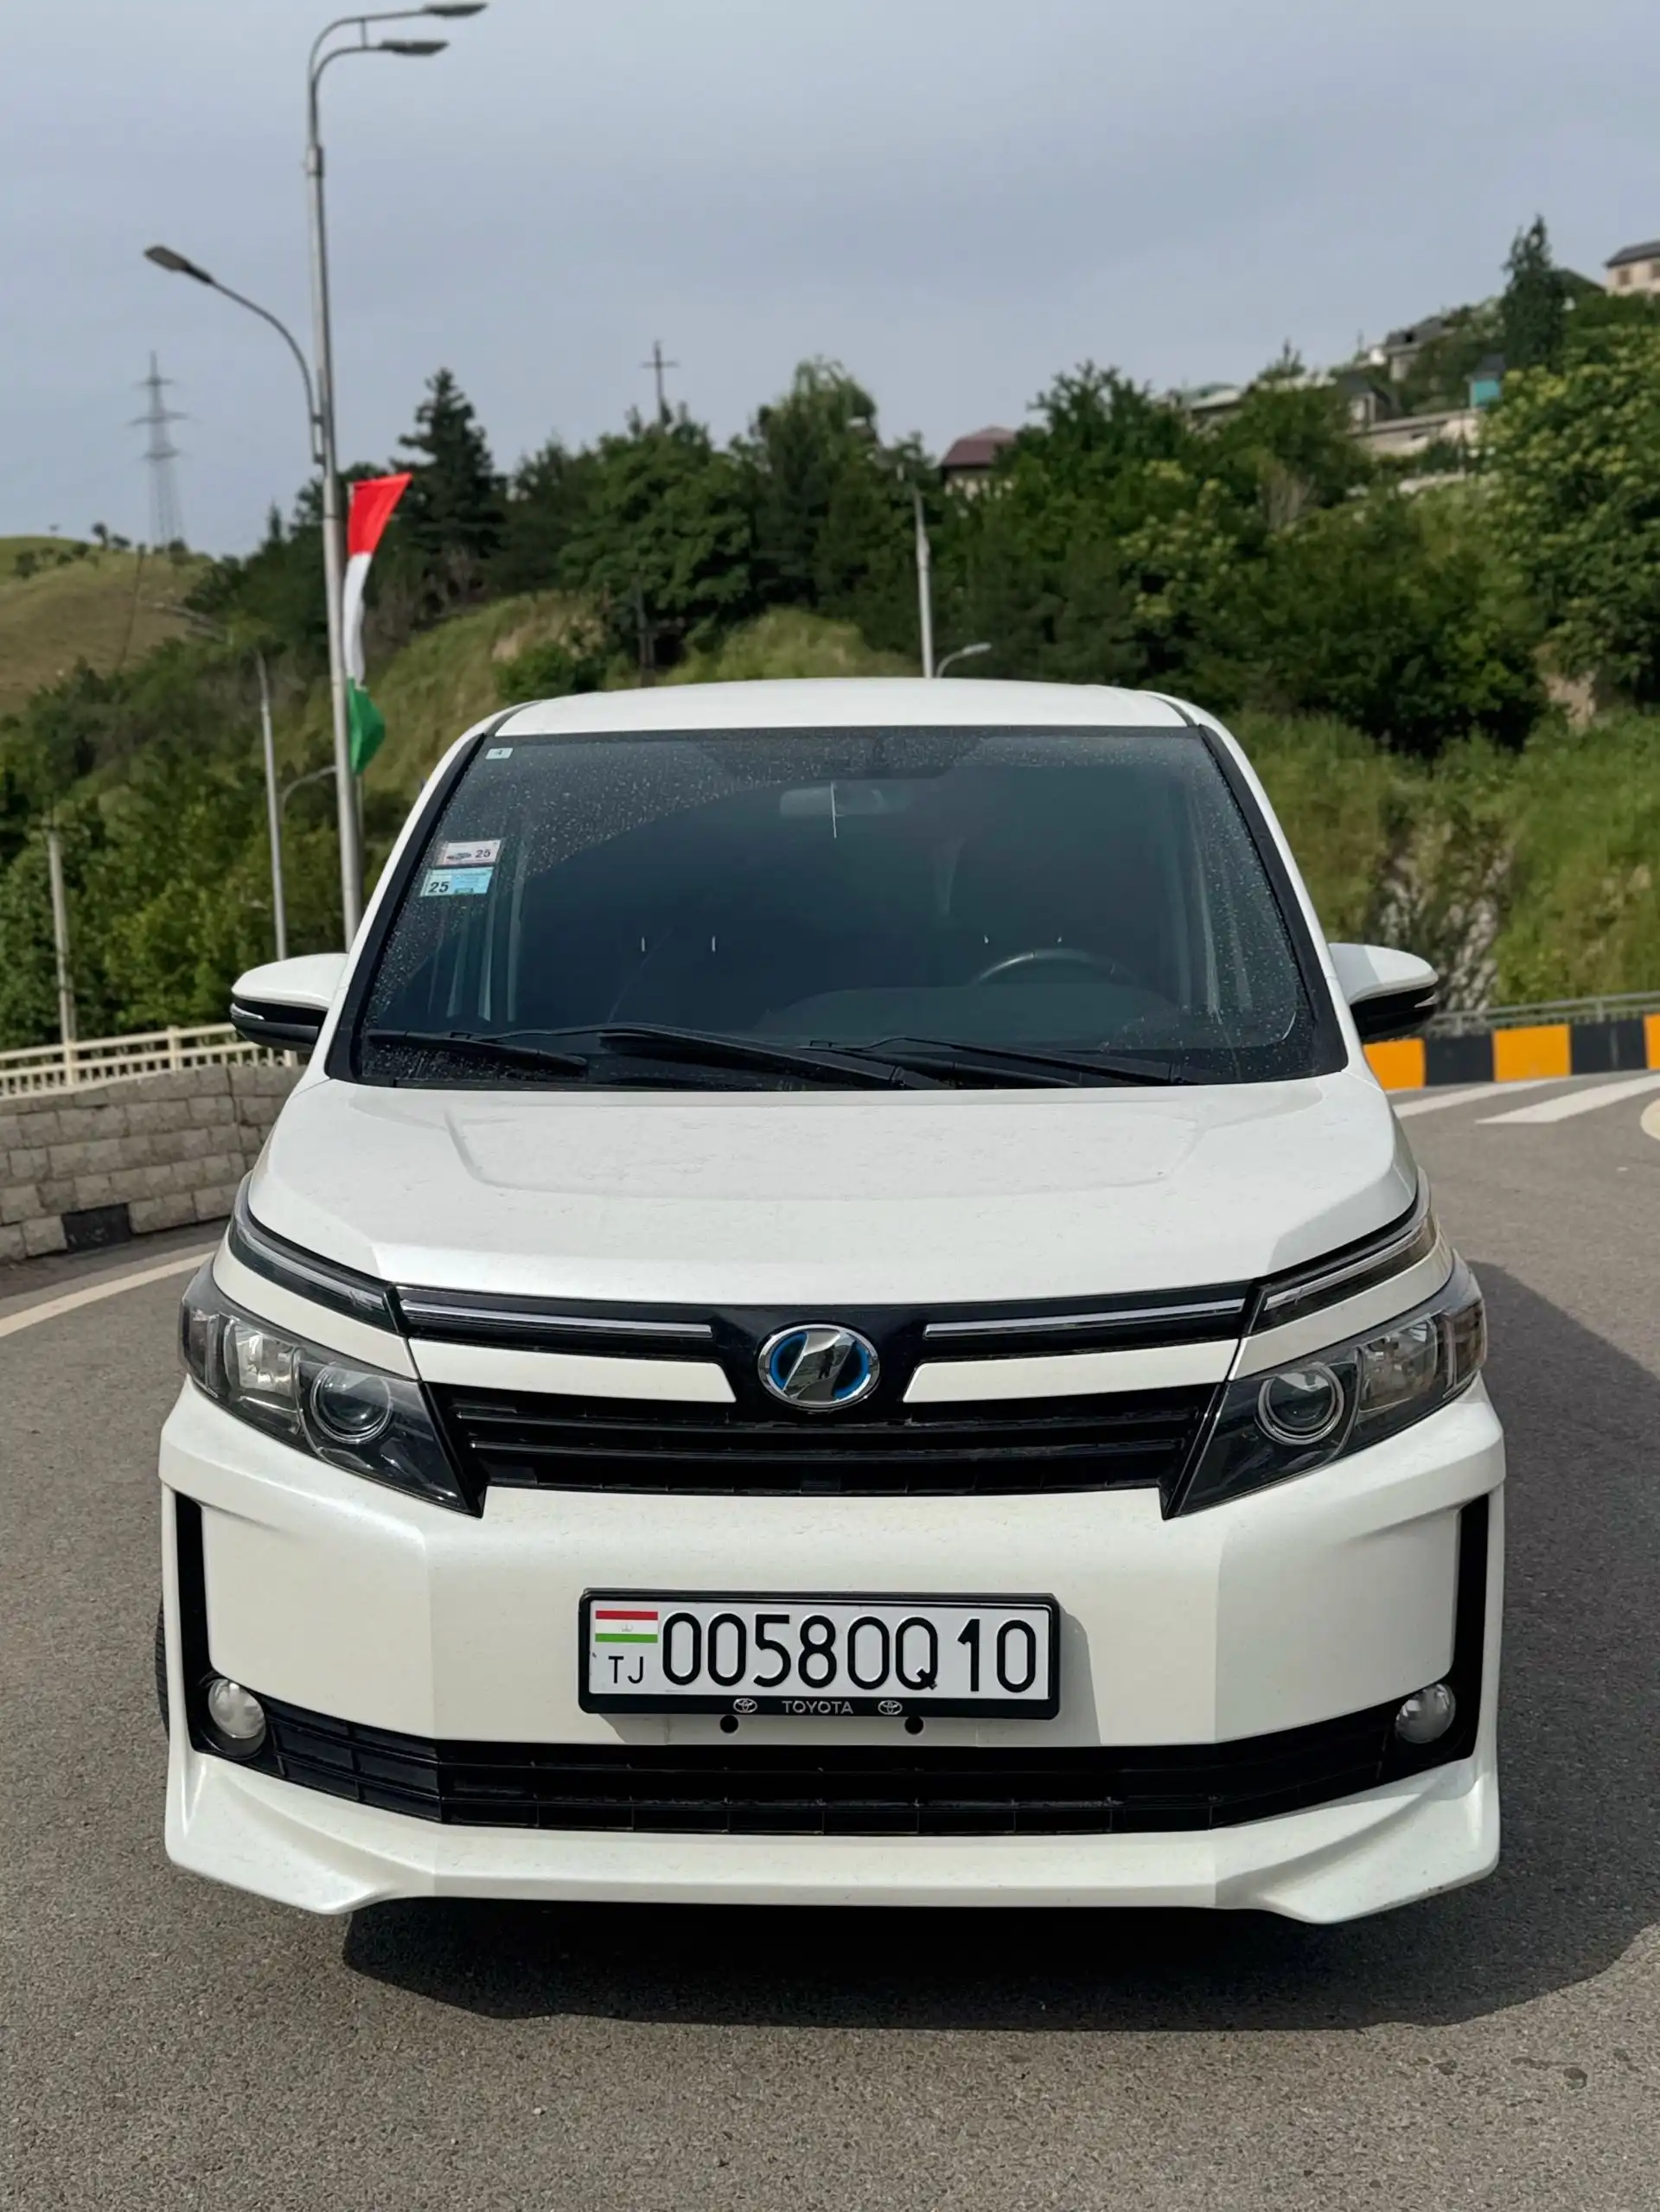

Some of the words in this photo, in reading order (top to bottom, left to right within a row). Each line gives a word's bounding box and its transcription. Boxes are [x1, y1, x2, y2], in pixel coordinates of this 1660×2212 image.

[475, 849, 491, 857] 25
[428, 882, 450, 893] 25
[609, 1655, 644, 1684] TJ
[782, 1700, 853, 1714] TOYOTA
